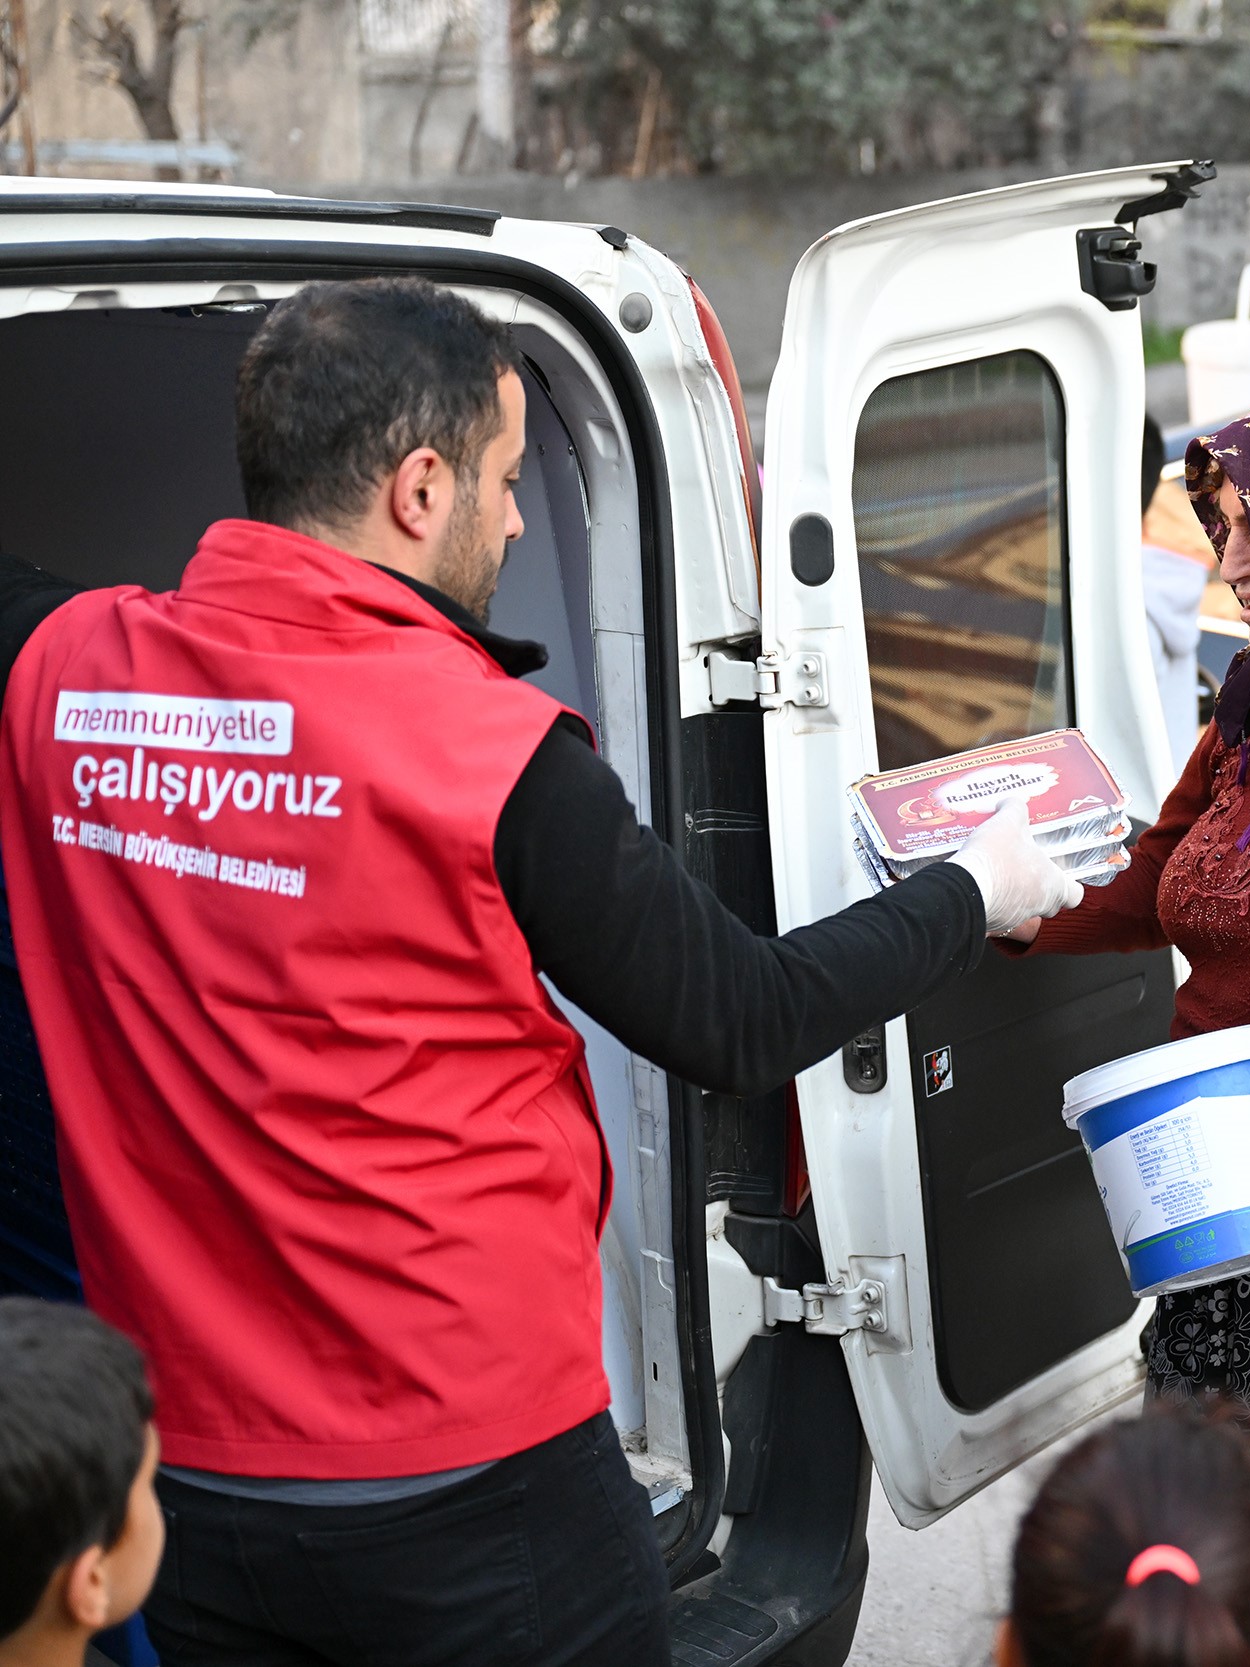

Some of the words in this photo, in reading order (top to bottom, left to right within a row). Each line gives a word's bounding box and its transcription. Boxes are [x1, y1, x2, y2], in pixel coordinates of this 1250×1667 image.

[62, 706, 277, 747] memnuniyetle
[899, 769, 938, 783] MERSİN
[1005, 742, 1059, 758] BELEDİYESİ
[72, 746, 342, 822] çalışıyoruz
[946, 774, 1045, 804] Ramazanlar
[52, 815, 77, 844] T.C.
[78, 820, 124, 857] MERSİN
[124, 831, 219, 879] BÜYÜKŞEHİR
[219, 854, 307, 899] BELEDİYESİ
